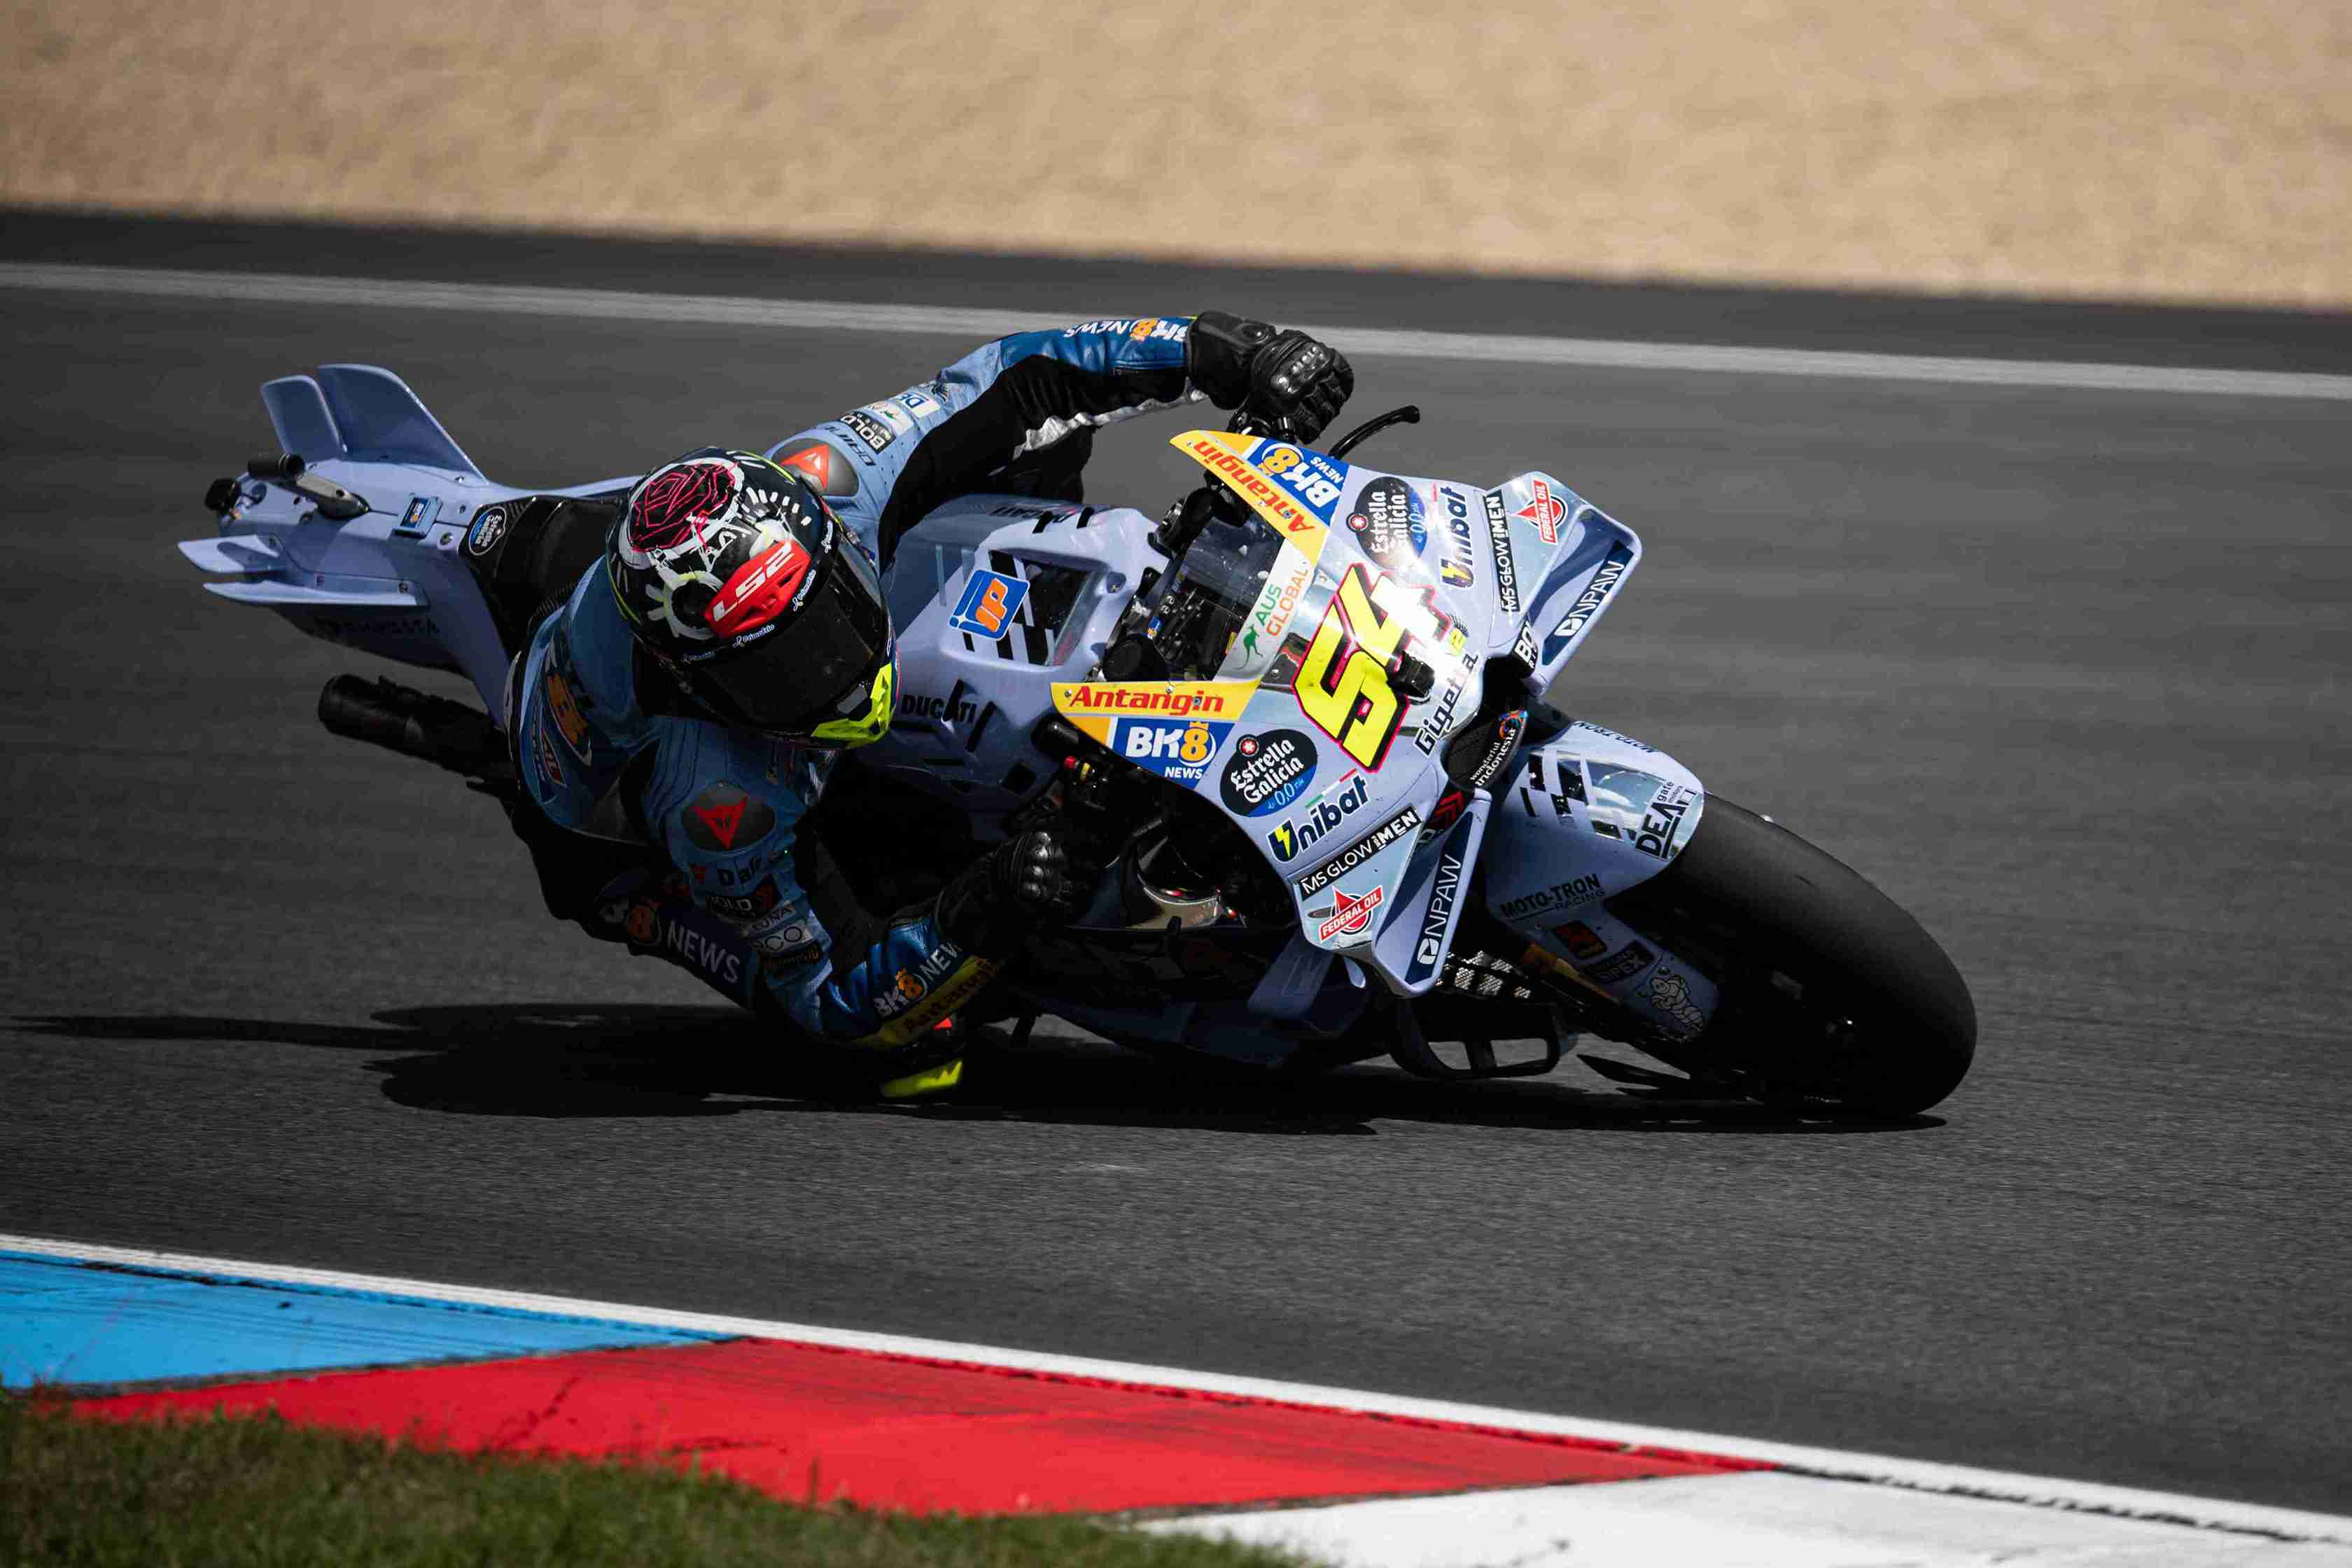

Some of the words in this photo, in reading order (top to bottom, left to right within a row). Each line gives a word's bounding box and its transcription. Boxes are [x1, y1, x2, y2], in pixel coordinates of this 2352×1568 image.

[841, 415, 886, 450] BOLD
[1193, 440, 1316, 533] Antangin
[1261, 444, 1343, 508] BK8
[1310, 456, 1344, 484] NEWS
[1535, 484, 1547, 500] OIL
[1367, 491, 1390, 554] Estrella
[1540, 501, 1554, 540] FEDERAL
[711, 544, 795, 622] LS2
[1494, 539, 1513, 585] GLOW
[1255, 584, 1282, 626] AUS
[1265, 571, 1306, 637] GLOBAL
[1570, 560, 1625, 621] NPAW
[1068, 685, 1224, 716] Antangin
[1125, 724, 1212, 762] BK8
[1231, 739, 1295, 792] Estrella
[1164, 766, 1203, 780] NEWS
[1244, 757, 1304, 803] Galicia
[1657, 780, 1675, 802] gate
[1269, 776, 1369, 861] Unibat
[1301, 876, 1328, 895] MS
[1327, 839, 1372, 876] GLOW
[1377, 811, 1418, 845] MEN
[1322, 904, 1364, 937] FEDERAL
[1364, 890, 1380, 909] OIL
[1425, 853, 1462, 937] NPAW
[1501, 874, 1601, 918] MOTO-TRON
[666, 927, 741, 985] NEWS
